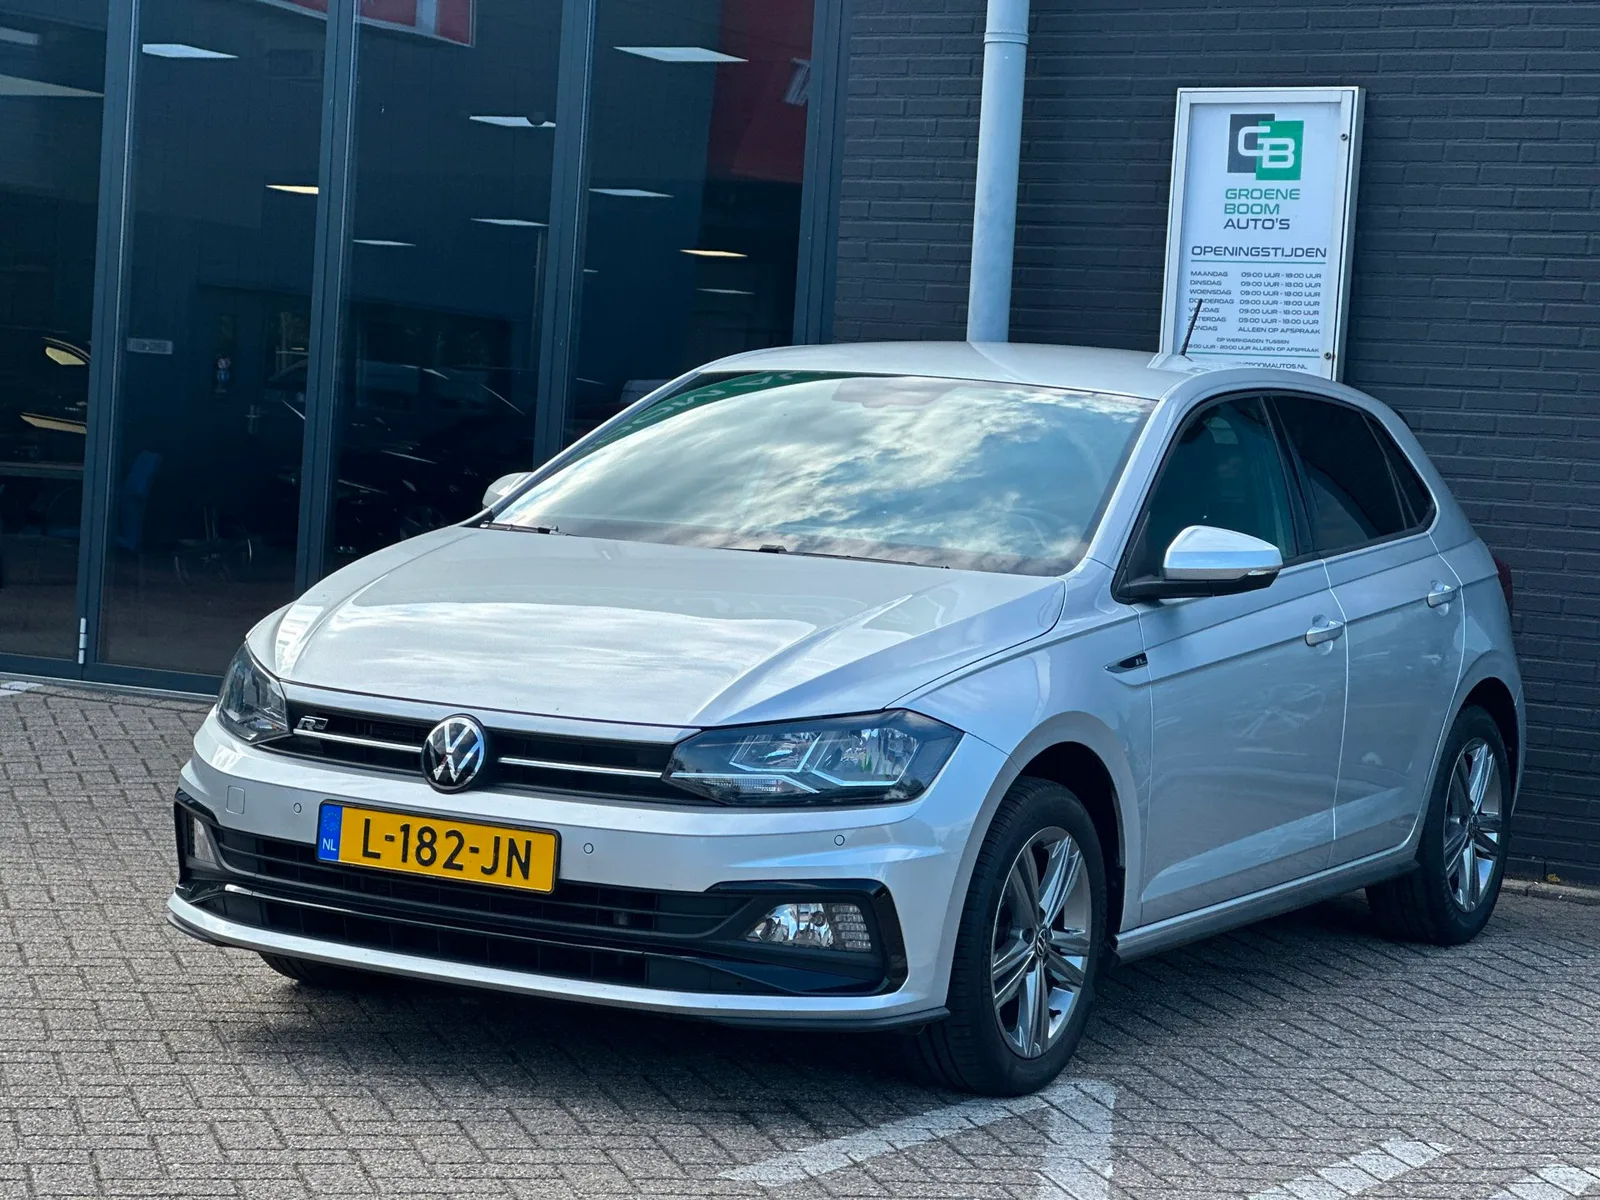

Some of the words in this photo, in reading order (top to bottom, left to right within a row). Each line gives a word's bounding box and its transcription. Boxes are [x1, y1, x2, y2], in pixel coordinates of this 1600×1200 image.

[1225, 188, 1300, 200] GROENE
[1224, 203, 1280, 214] BOOM
[1224, 218, 1290, 230] AUTO'S
[1191, 245, 1327, 258] OPENINGSTIJDEN
[322, 838, 336, 852] NL
[362, 818, 532, 880] L-182-JN
